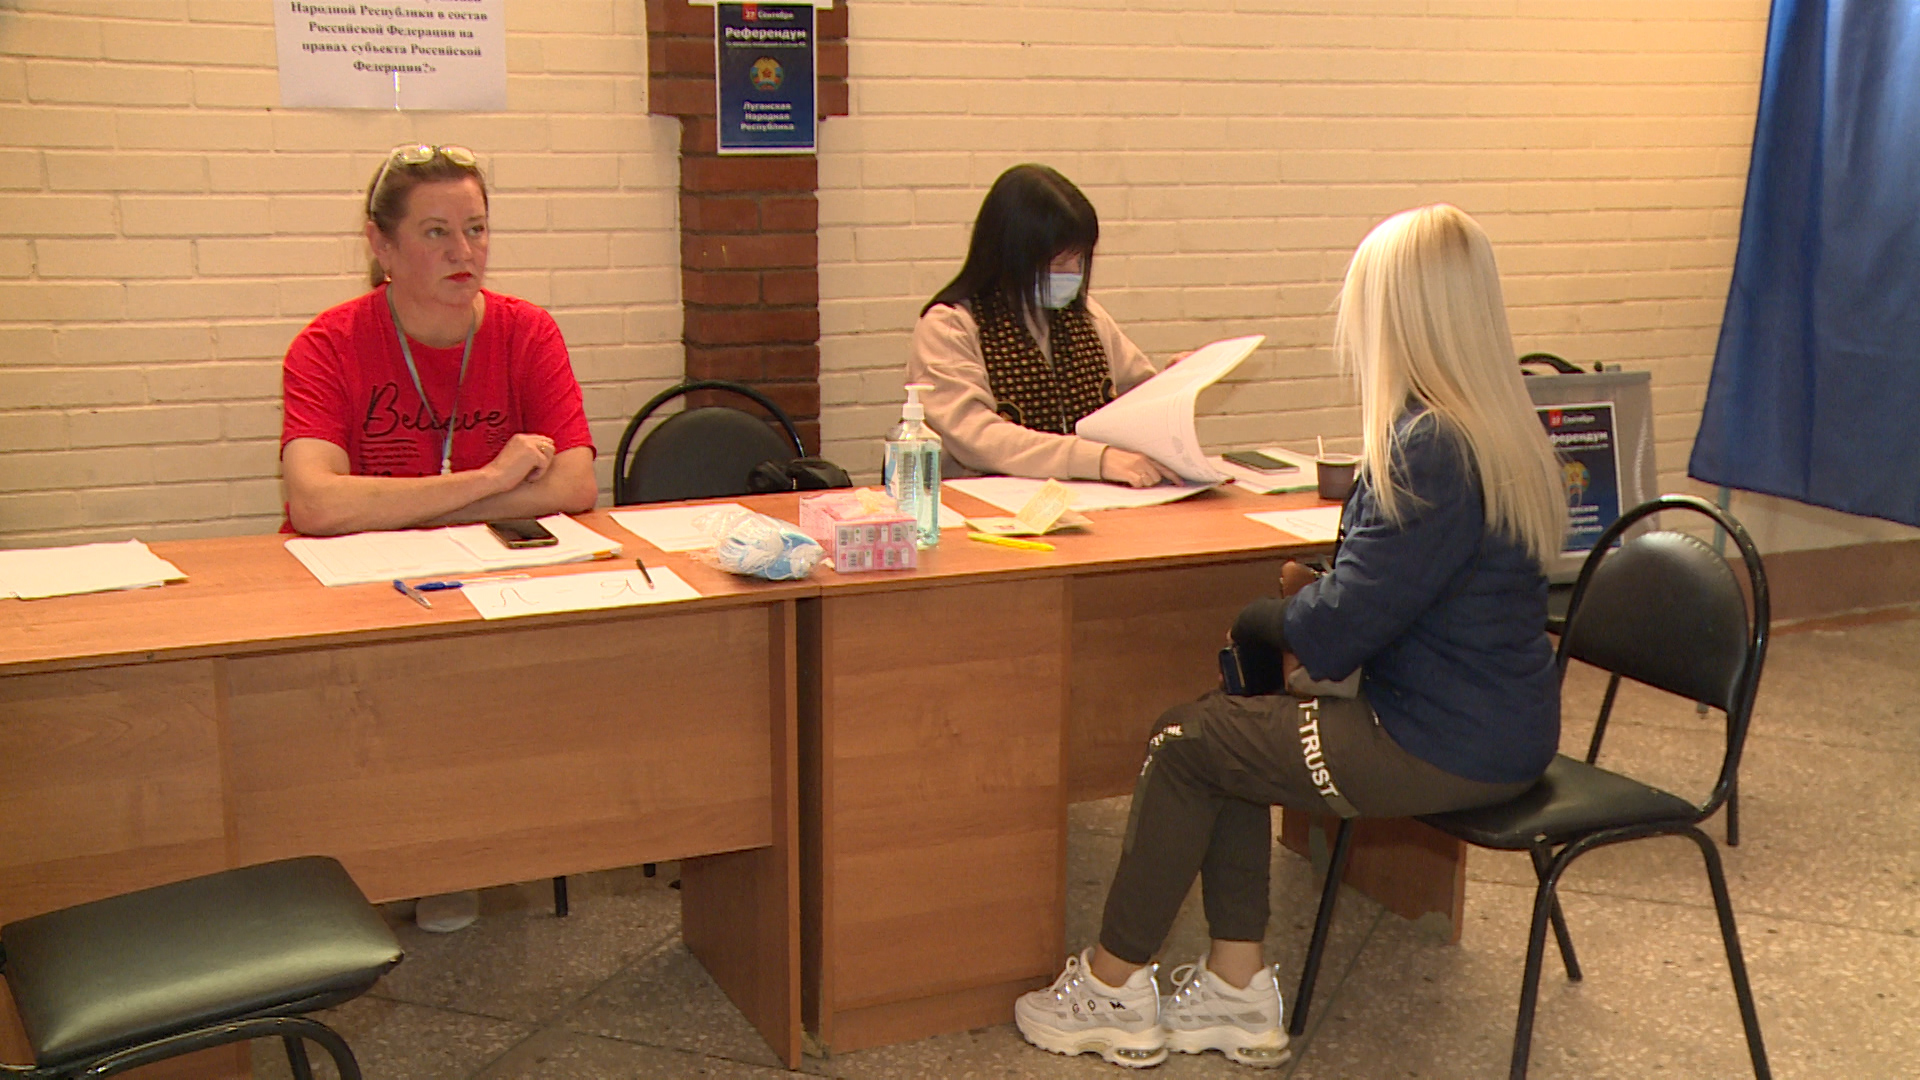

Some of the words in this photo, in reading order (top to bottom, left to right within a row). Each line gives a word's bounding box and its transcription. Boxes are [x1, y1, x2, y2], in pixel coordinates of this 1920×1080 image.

[291, 1, 356, 16] Народной
[360, 4, 434, 19] Республики
[437, 10, 445, 18] в
[448, 10, 488, 20] состав
[309, 21, 383, 34] Российской
[386, 24, 455, 39] Федерации
[459, 29, 474, 38] на
[725, 27, 806, 40] Референдум
[302, 42, 348, 54] правах
[351, 42, 407, 58] субъекта
[411, 44, 482, 57] Российской
[743, 101, 792, 112] Луганская
[745, 112, 790, 121] Народная
[740, 122, 795, 132] Республика
